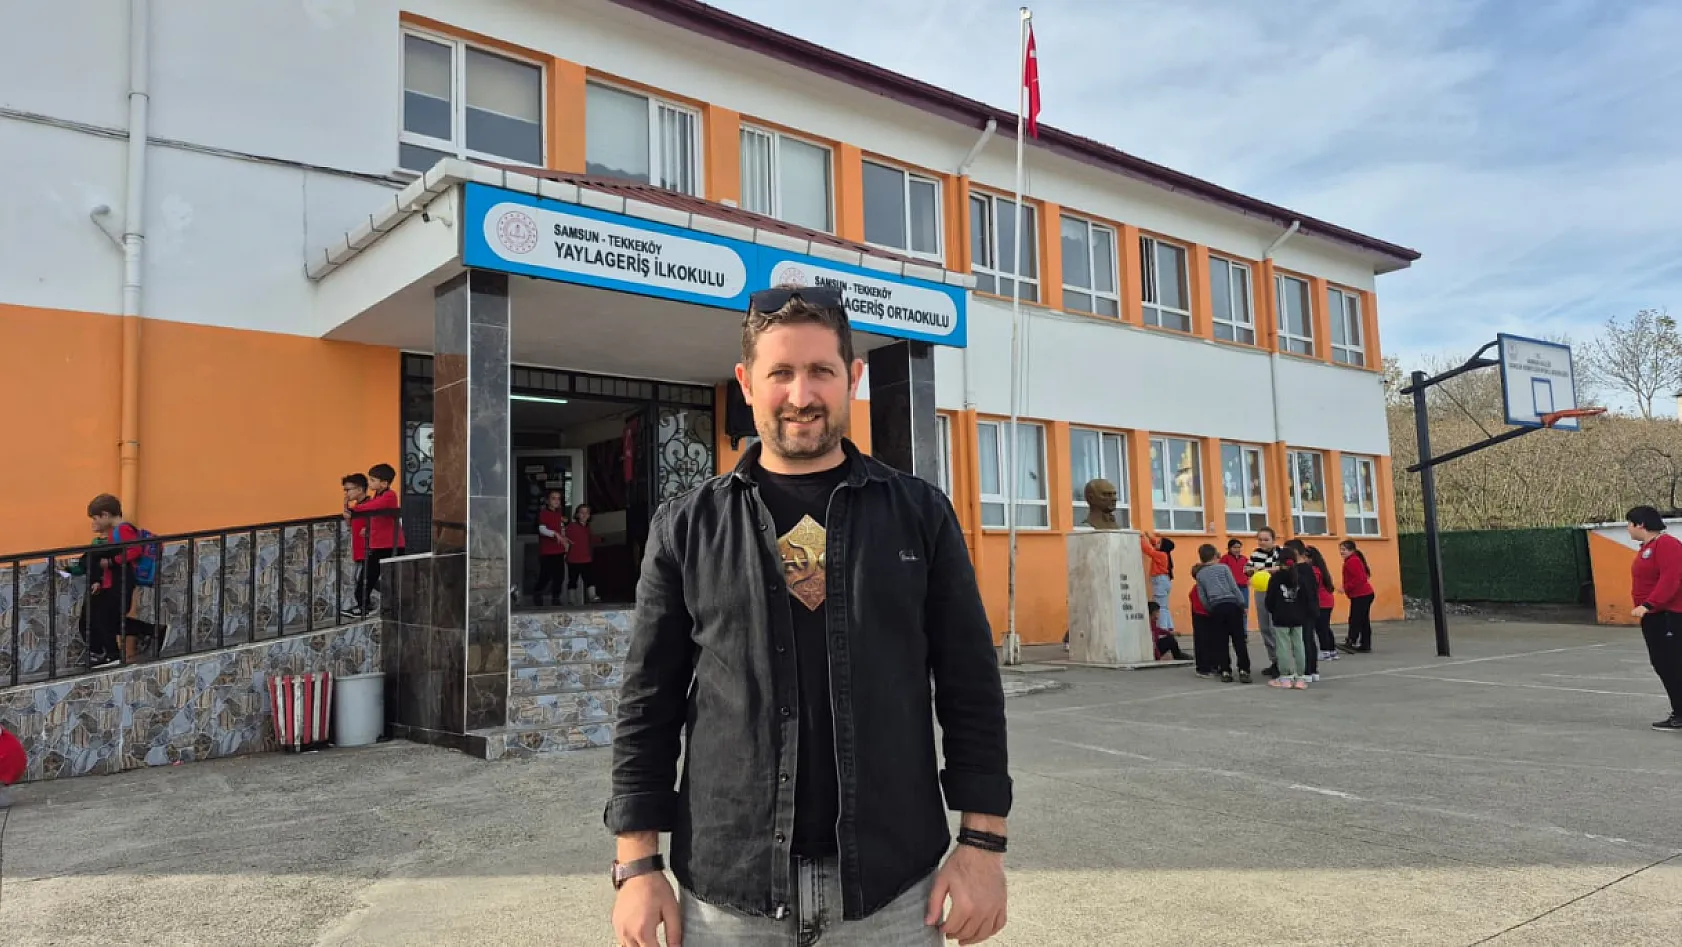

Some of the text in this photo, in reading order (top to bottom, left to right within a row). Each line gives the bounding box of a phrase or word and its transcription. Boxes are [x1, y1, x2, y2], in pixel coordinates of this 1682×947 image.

[553, 224, 599, 243] SAMSUN
[608, 235, 662, 255] TEKKEKÖY
[554, 242, 725, 287] YAYLAGERİŞ İLKOKULU
[854, 284, 892, 299] TEKKEKÖY
[844, 297, 949, 328] AGERİŞ ORTAOKULU
